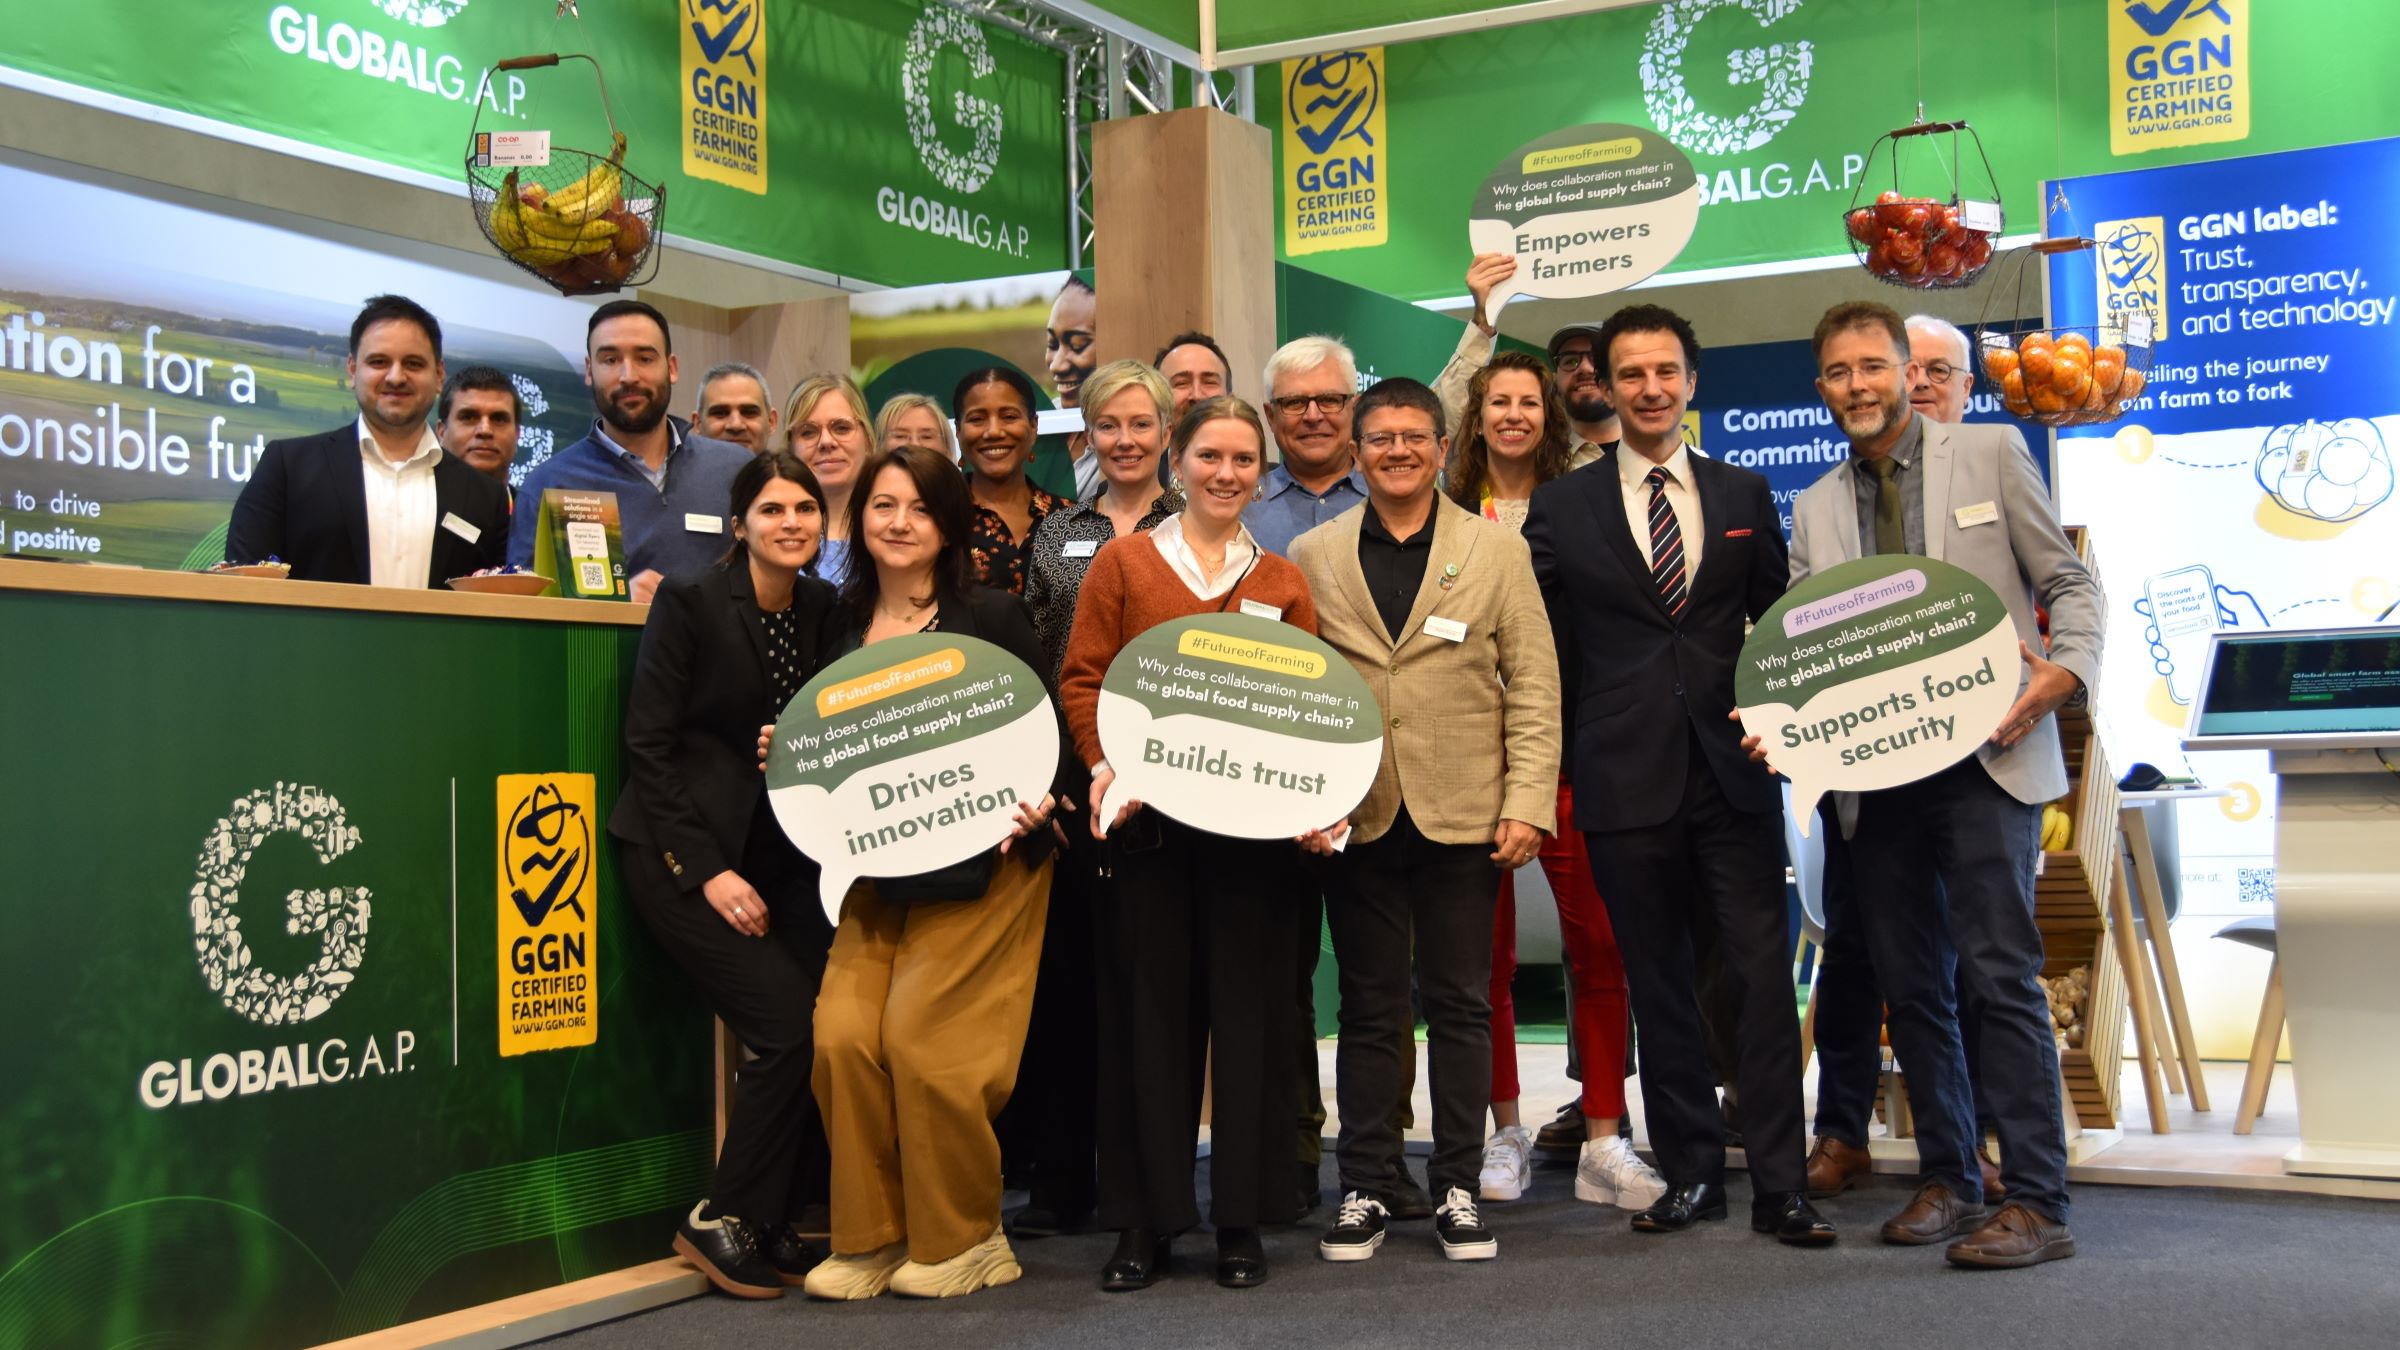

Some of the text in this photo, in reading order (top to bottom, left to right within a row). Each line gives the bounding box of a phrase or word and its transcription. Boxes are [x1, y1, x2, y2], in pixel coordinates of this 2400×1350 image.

[269, 5, 527, 120] GLOBALG.A.P.
[2126, 34, 2231, 81] GGN
[692, 67, 757, 120] GGN
[2126, 74, 2233, 103] CERTIFIED
[693, 108, 758, 141] CERTIFIED
[2127, 94, 2232, 123] FARMING
[2128, 113, 2232, 136] WWW.GGN.ORG
[693, 128, 758, 162] FARMING
[694, 148, 758, 176] WWW.GGN.ORG
[1532, 142, 1632, 167] #FutureofFarming
[1296, 154, 1375, 193] GGN
[1493, 161, 1674, 198] Why does collaboration matter in
[1297, 188, 1376, 212] CERTIFIED
[1495, 176, 1671, 213] the global food supply chain?
[877, 186, 1029, 260] GLOBALG.A.P.
[1297, 205, 1375, 228] FARMING
[1298, 222, 1376, 239] WWW.GGN.ORG
[2178, 200, 2337, 241] GGN label:
[1515, 219, 1651, 255] Empowers
[1532, 253, 1633, 281] farmers
[2179, 244, 2254, 272] Trust,
[2106, 290, 2158, 310] GGN
[2181, 267, 2367, 305] transparency,
[2182, 307, 2230, 336] and
[2239, 295, 2395, 331] technology
[144, 325, 214, 396] for
[230, 364, 256, 404] a
[2204, 359, 2240, 379] the
[2244, 354, 2329, 379] journey
[2158, 390, 2210, 409] farm
[2216, 387, 2240, 404] to
[2247, 381, 2293, 402] fork
[16, 489, 101, 518] to drive
[569, 513, 585, 521] single
[14, 526, 101, 553] positive
[1793, 578, 1915, 627] #FutureofFarming
[2157, 586, 2192, 599] Discover
[2159, 592, 2206, 608] the roots of
[2162, 603, 2201, 619] your food
[1756, 591, 1974, 673] Why does collaboration matter in
[1192, 636, 1315, 673] #FutureofFarming
[1765, 611, 1977, 692] the global food supply chain?
[827, 659, 953, 707] #FutureofFarming
[1138, 656, 1359, 710] Why does collaboration matter in
[787, 672, 1012, 754] Why does collaboration matter in
[1136, 677, 1354, 729] the global food supply chain?
[1780, 656, 1996, 749] Supports food
[796, 692, 1015, 774] the global food supply chain?
[1839, 714, 1956, 766] security
[1143, 737, 1326, 796] Builds trust
[868, 762, 975, 812] Drives
[844, 786, 1018, 856] innovation
[511, 931, 586, 976] GGN
[511, 973, 587, 998] CERTIFIED
[511, 994, 587, 1021] FARMING
[512, 1015, 587, 1035] WWW.GGN.ORG
[139, 1030, 415, 1108] GLOBALG.A.P.
